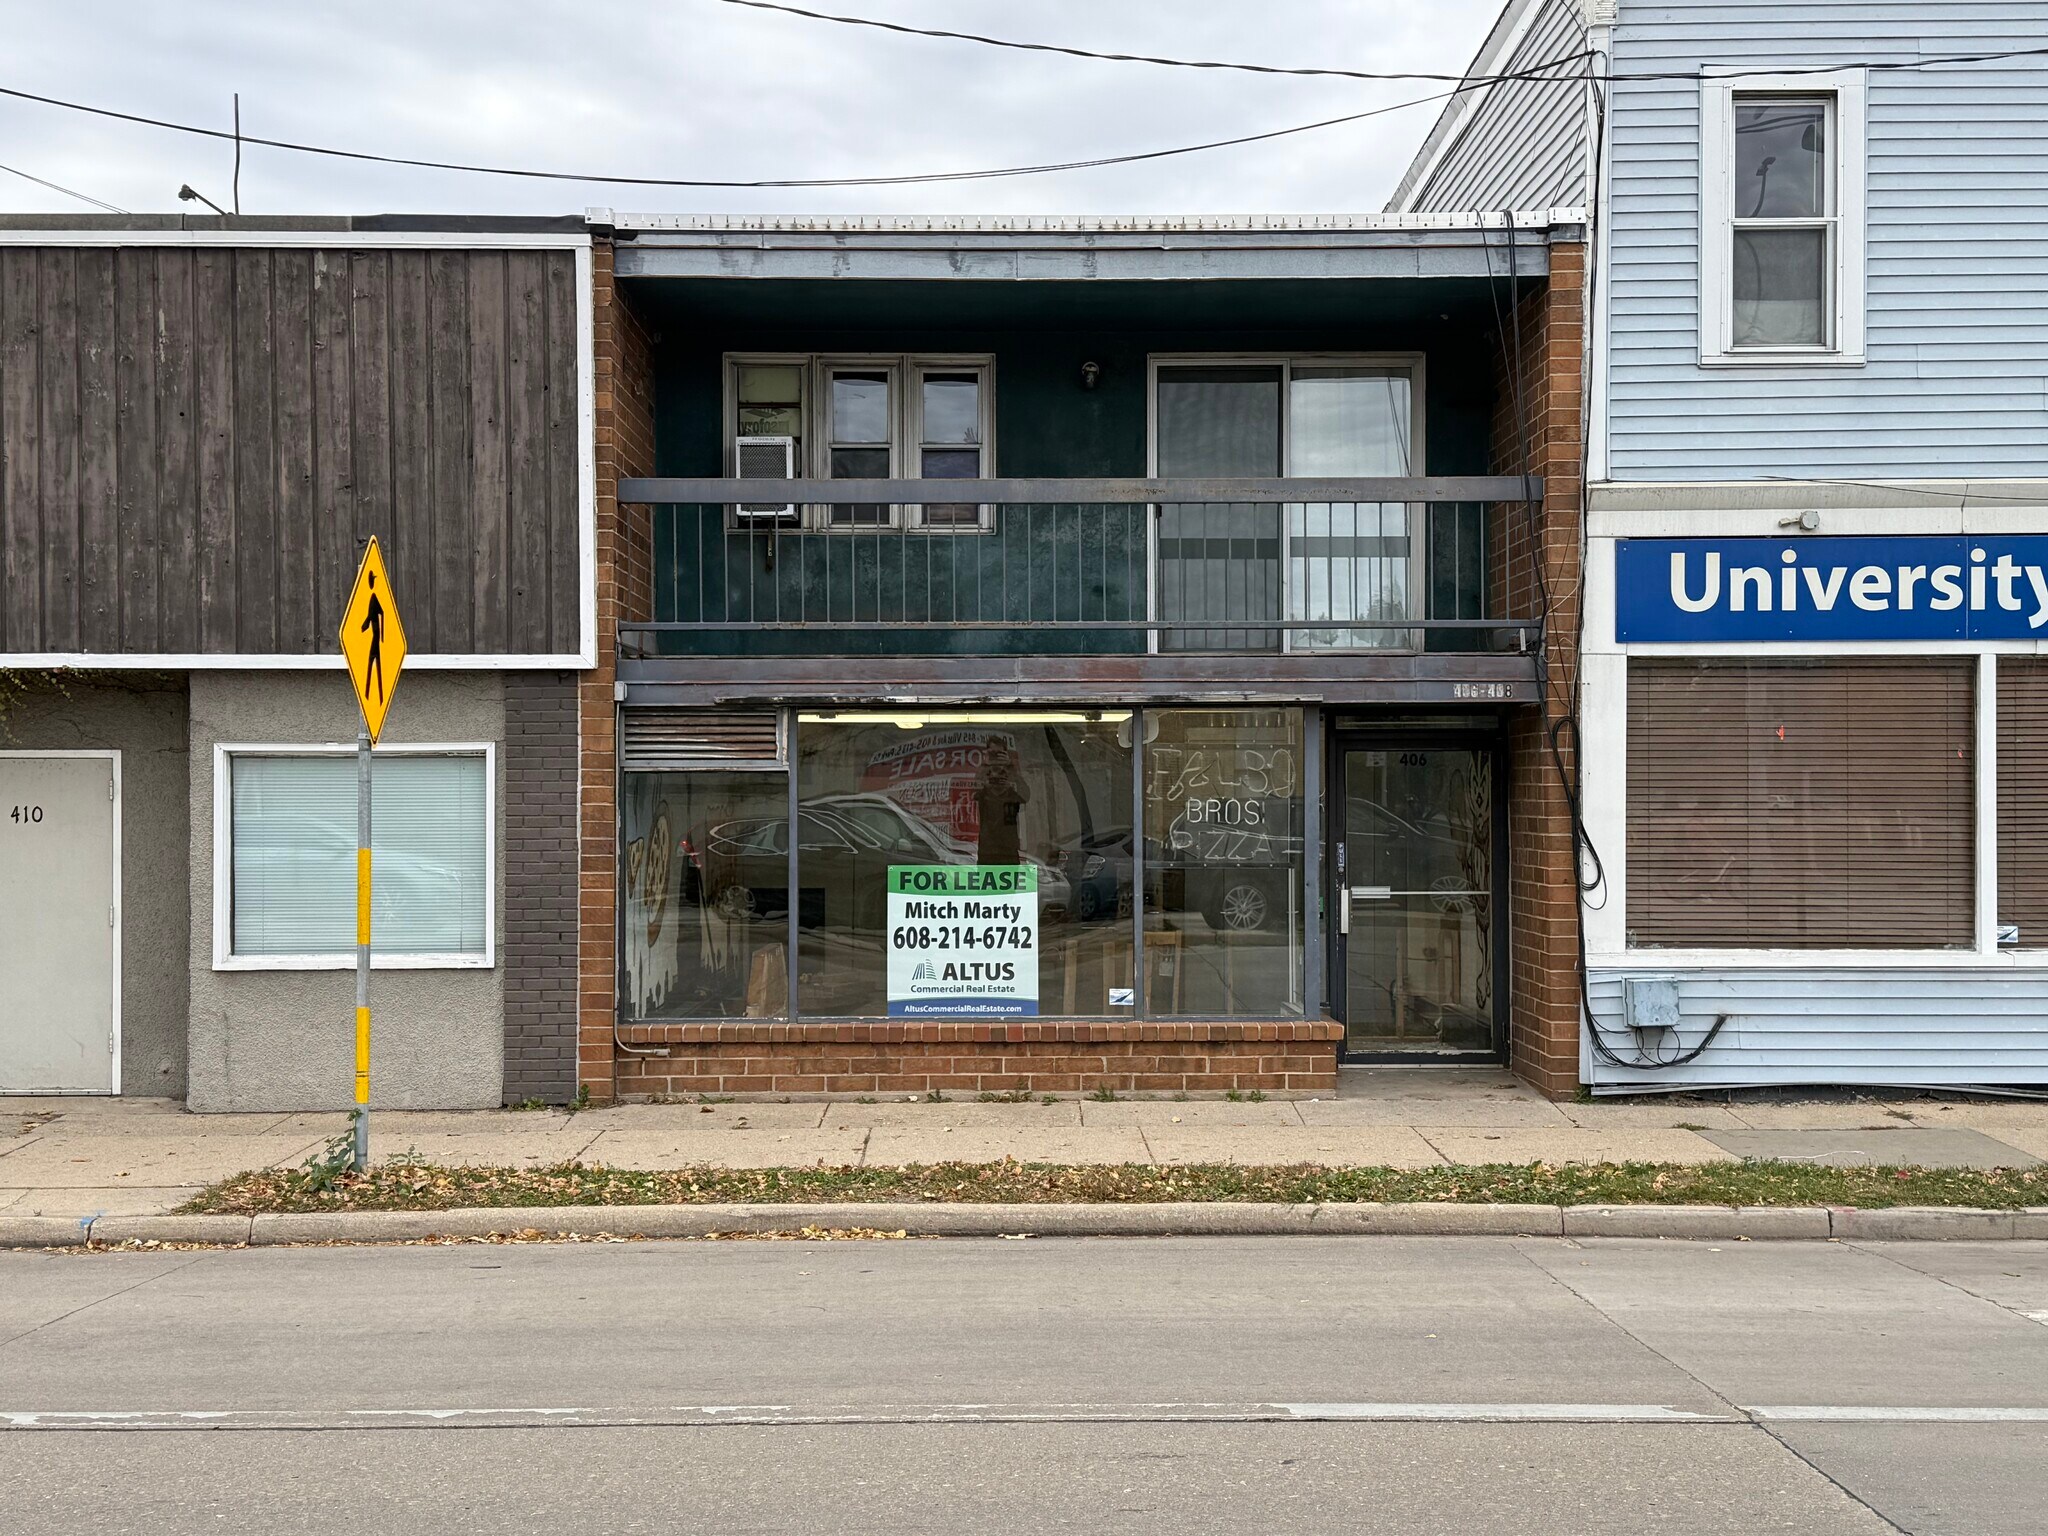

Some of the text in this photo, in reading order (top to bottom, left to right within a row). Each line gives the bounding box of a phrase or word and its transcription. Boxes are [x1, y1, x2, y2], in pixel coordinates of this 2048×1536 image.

[1670, 548, 2048, 629] University
[1400, 753, 1427, 767] 406
[10, 805, 43, 824] 410
[899, 871, 1027, 891] FOR LEASE
[905, 901, 1021, 923] Mitch Marty
[893, 926, 1032, 950] 608-214-6742
[942, 962, 1015, 981] ALTUS
[910, 984, 1016, 993] Commercial Real Estate
[904, 1005, 1022, 1013] AltusCommercialRealEstate.com
